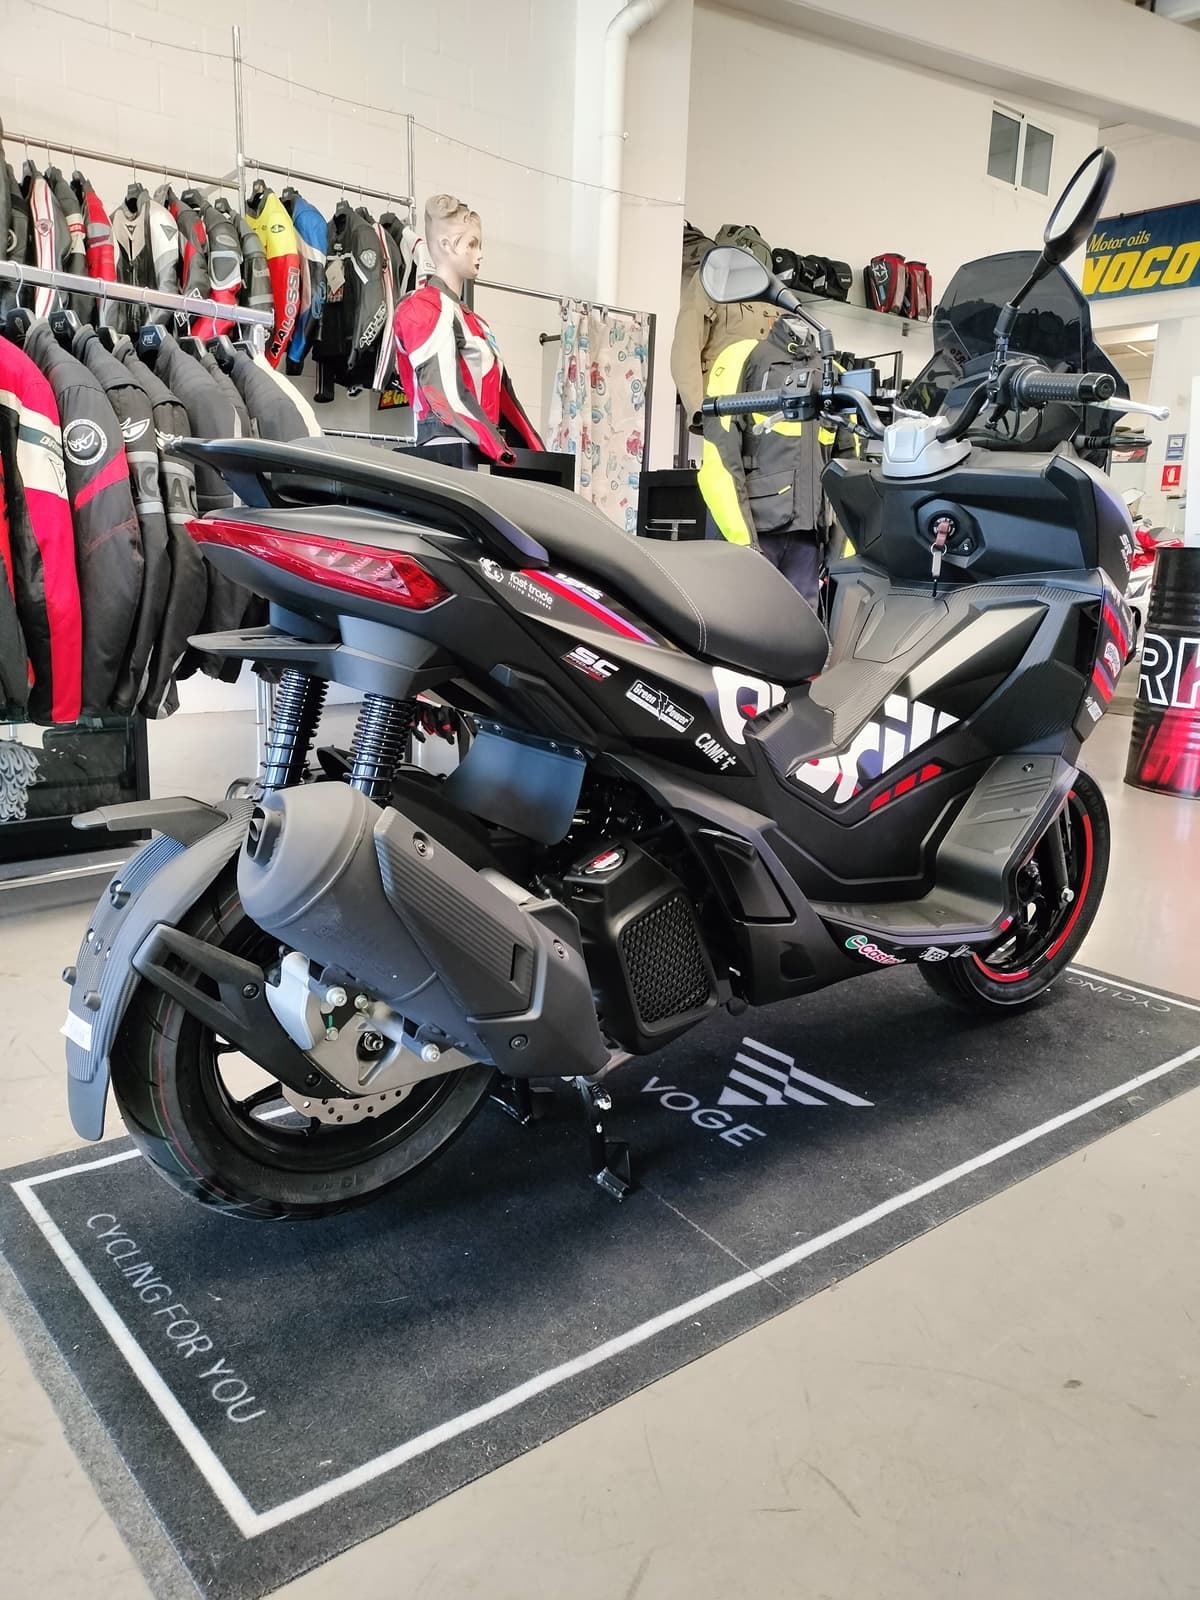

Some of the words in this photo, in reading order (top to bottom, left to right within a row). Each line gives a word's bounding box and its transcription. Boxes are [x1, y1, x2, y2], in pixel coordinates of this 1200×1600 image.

[1087, 232, 1126, 252] Motor
[1127, 230, 1152, 246] oils
[271, 266, 300, 359] MALOSSI
[509, 571, 528, 592] fast
[528, 583, 553, 604] trade
[566, 646, 620, 678] SC
[632, 683, 657, 705] Green
[664, 704, 689, 725] Power
[1065, 976, 1171, 1013] CYCLING
[640, 1076, 768, 1147] VOGE
[86, 1213, 173, 1304] CYCLING
[153, 1303, 213, 1359] FOR
[199, 1358, 267, 1423] YOU
